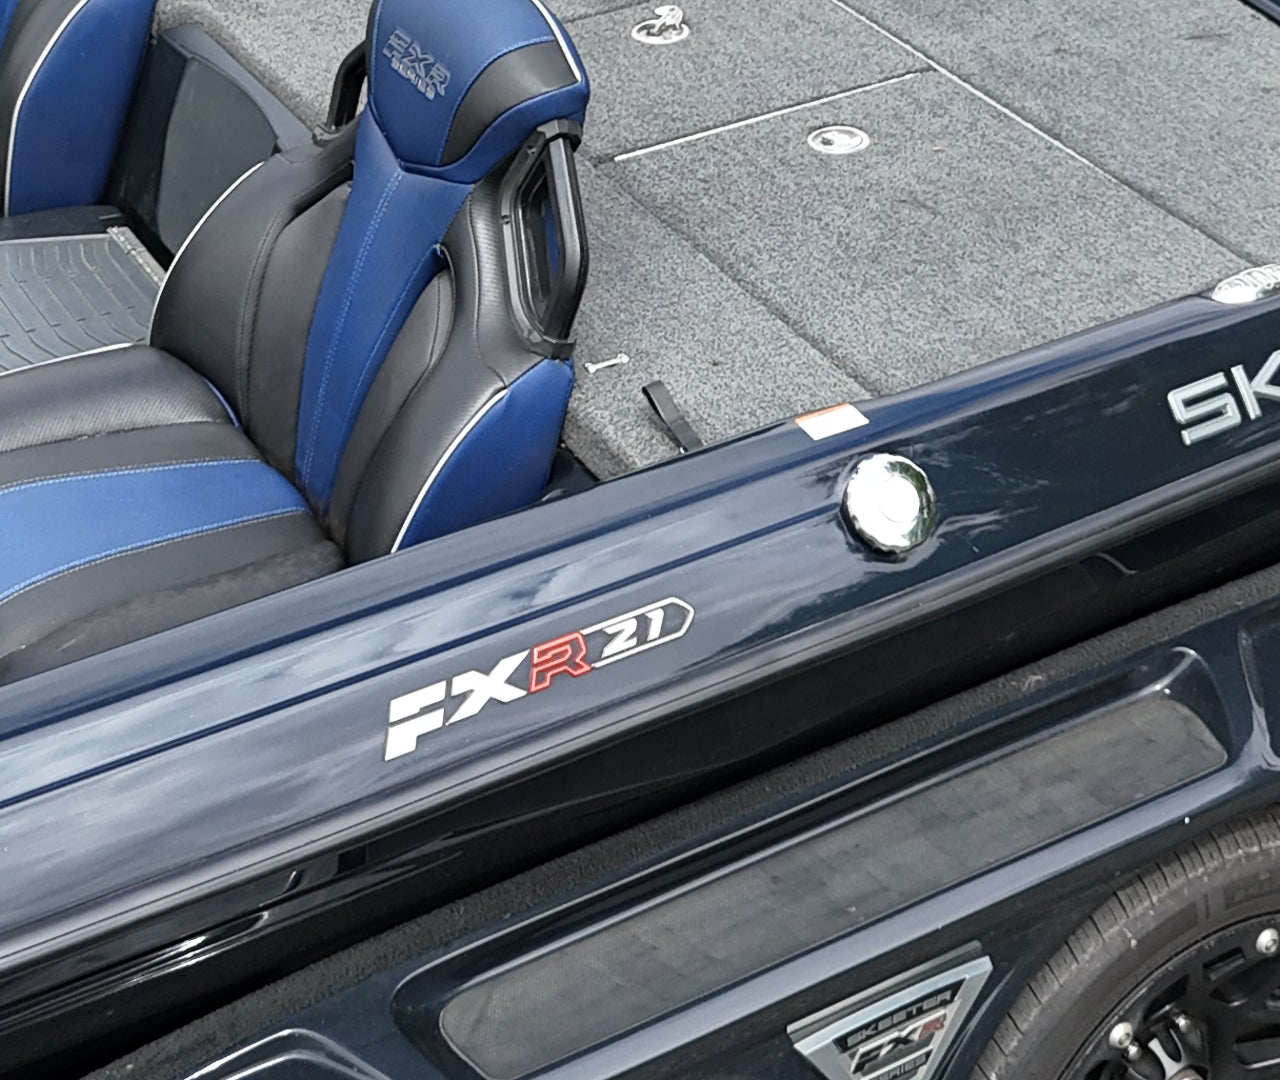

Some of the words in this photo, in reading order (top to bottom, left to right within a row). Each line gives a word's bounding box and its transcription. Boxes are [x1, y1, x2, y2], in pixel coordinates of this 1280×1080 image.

[382, 26, 451, 97] FXR
[385, 632, 592, 762] FXR
[846, 990, 953, 1047] SKEETER
[850, 1009, 949, 1074] FXR
